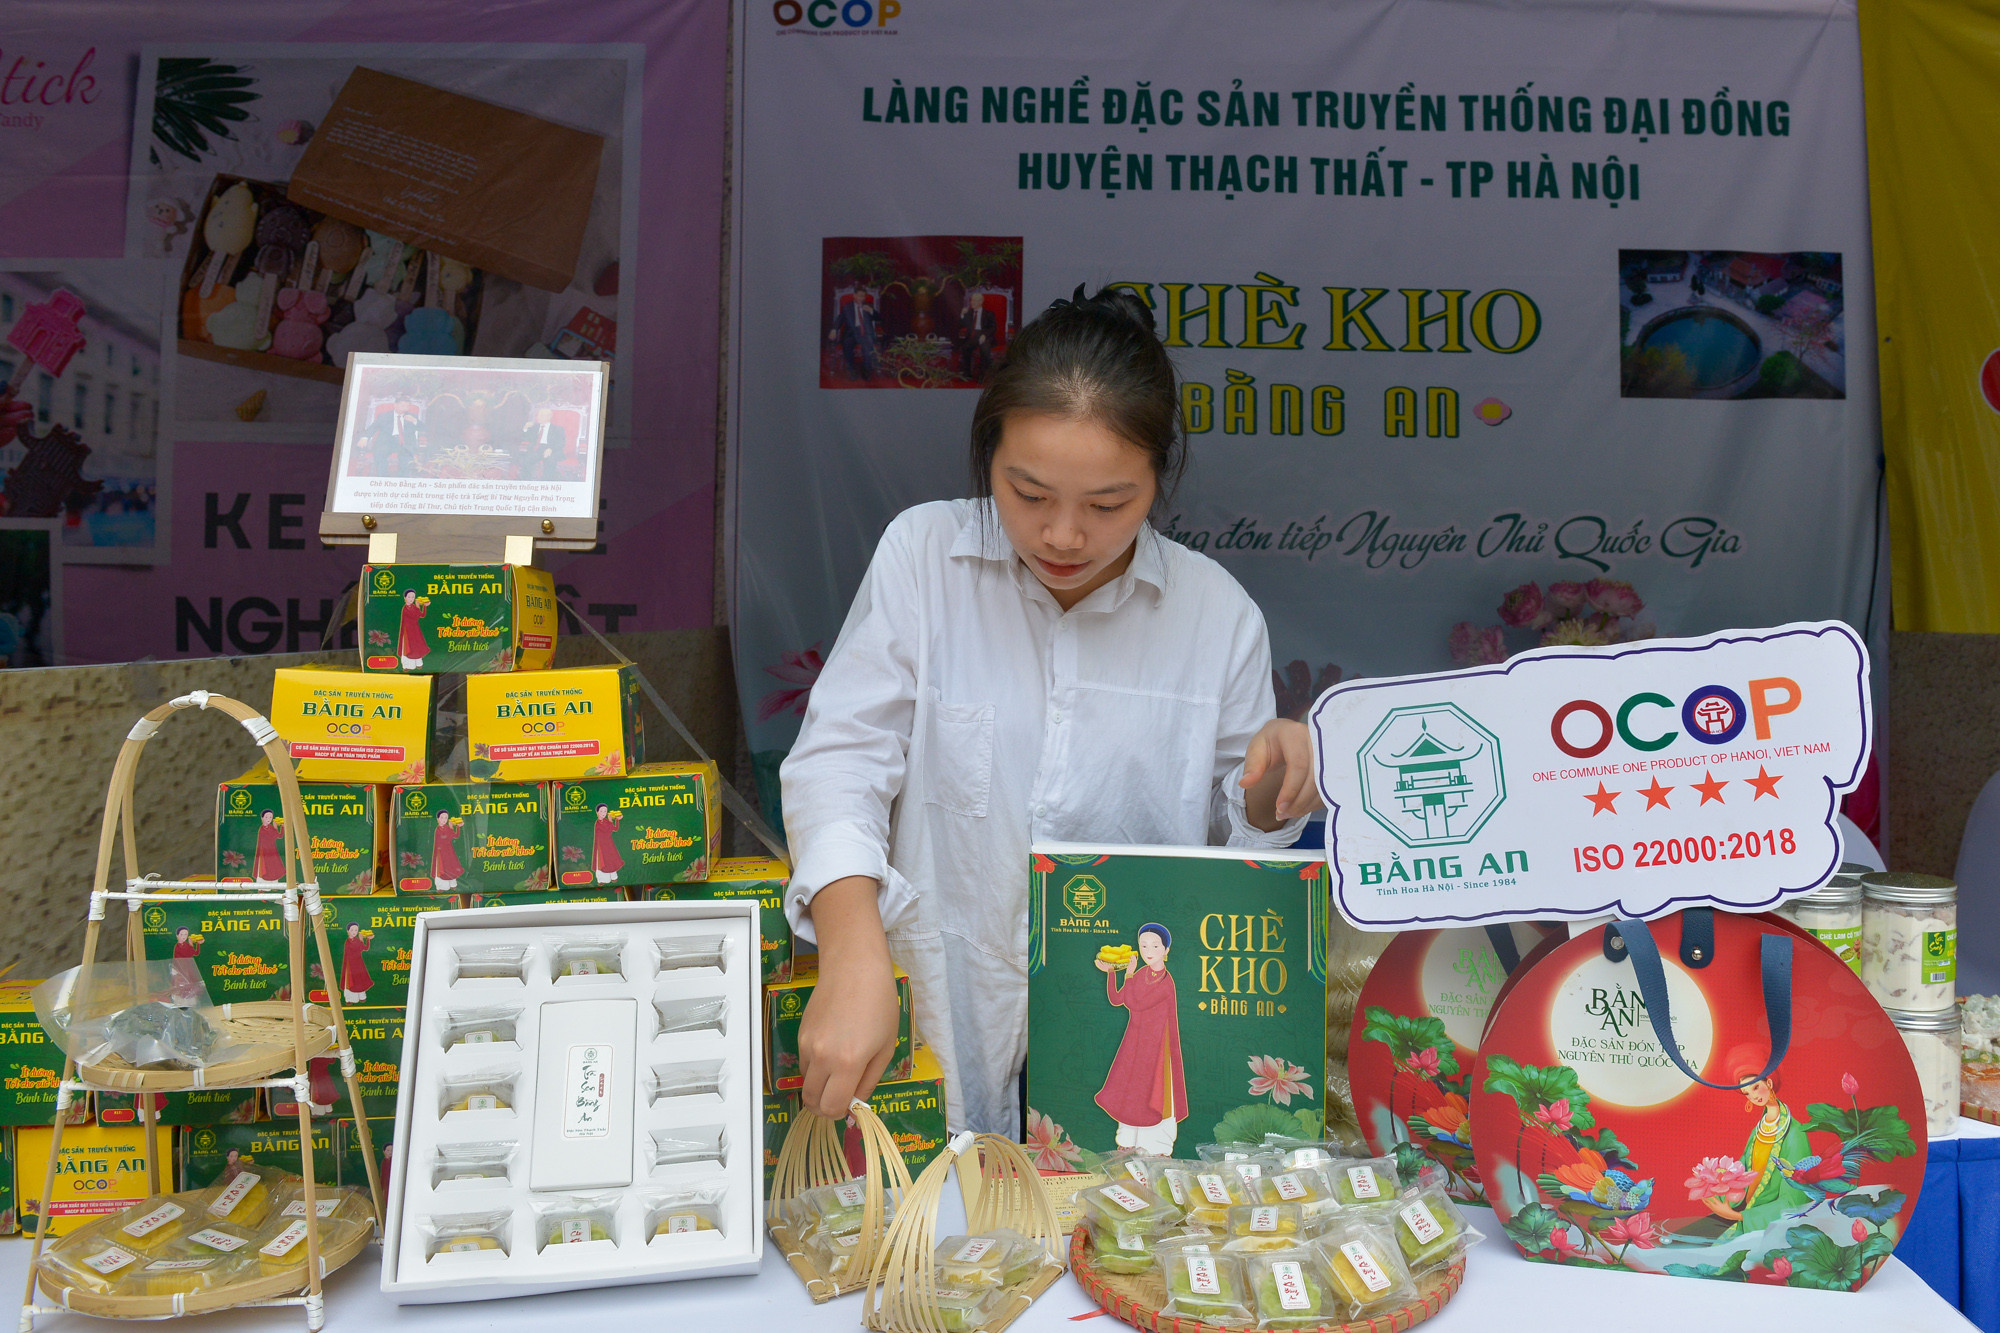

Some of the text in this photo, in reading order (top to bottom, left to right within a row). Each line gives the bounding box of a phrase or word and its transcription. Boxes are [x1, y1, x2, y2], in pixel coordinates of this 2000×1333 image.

[773, 0, 901, 28] OCOP
[862, 75, 1791, 143] LÀNG NGHỀ ĐẶC SẢN TRUYỀN THỐNG ĐẠI ĐỒNG
[1018, 144, 1153, 199] HUYỆN
[1165, 154, 1298, 201] THẠCH
[1310, 146, 1408, 198] THẤT
[1446, 160, 1494, 198] TP
[1506, 153, 1560, 199] HÀ
[1572, 155, 1640, 208] NỘI
[1322, 286, 1542, 354] KHO
[1181, 369, 1460, 437] BẰNG AN
[1215, 516, 1272, 550] đón
[1277, 515, 1332, 561] tiếp
[1335, 510, 1467, 569] Nguyên
[1476, 513, 1548, 558] Thủ
[1554, 515, 1651, 573] Quốc
[1660, 516, 1742, 569] Gia
[427, 580, 502, 595] BẰNG AN
[328, 688, 341, 697] SẢN
[520, 690, 532, 698] SẢN
[302, 698, 401, 719] BẰNG AN
[496, 700, 593, 718] BẰNG AN
[1551, 676, 1802, 758] OCOP
[326, 722, 371, 735] OCOP
[522, 721, 565, 734] OCOP
[1532, 742, 1831, 783] ONE COMMUNE ONE PRODUCT OP HANOI, VIET NAM
[619, 792, 693, 809] BẰNG AN
[1573, 828, 1797, 872] ISO 22000:2018
[1358, 850, 1529, 885] BẰNG AN
[1401, 885, 1419, 894] Hoa
[1422, 883, 1435, 893] Hà
[1438, 882, 1454, 892] Nội
[1463, 879, 1489, 889] Since
[1492, 878, 1517, 887] 1984
[201, 911, 281, 932] BẰNG AN
[1060, 917, 1110, 928] BẰNG AN
[1199, 908, 1287, 953] CHÈ
[1198, 955, 1287, 995] KHO
[1210, 995, 1274, 1016] BẰNG AN
[1571, 1036, 1597, 1048] ĐẶC
[1600, 1038, 1625, 1050] SẢN
[1628, 1039, 1655, 1053] ĐÓN
[1558, 1050, 1606, 1063] NGUYÊN
[1609, 1052, 1634, 1065] THỦ
[73, 1178, 118, 1191] OCOP
